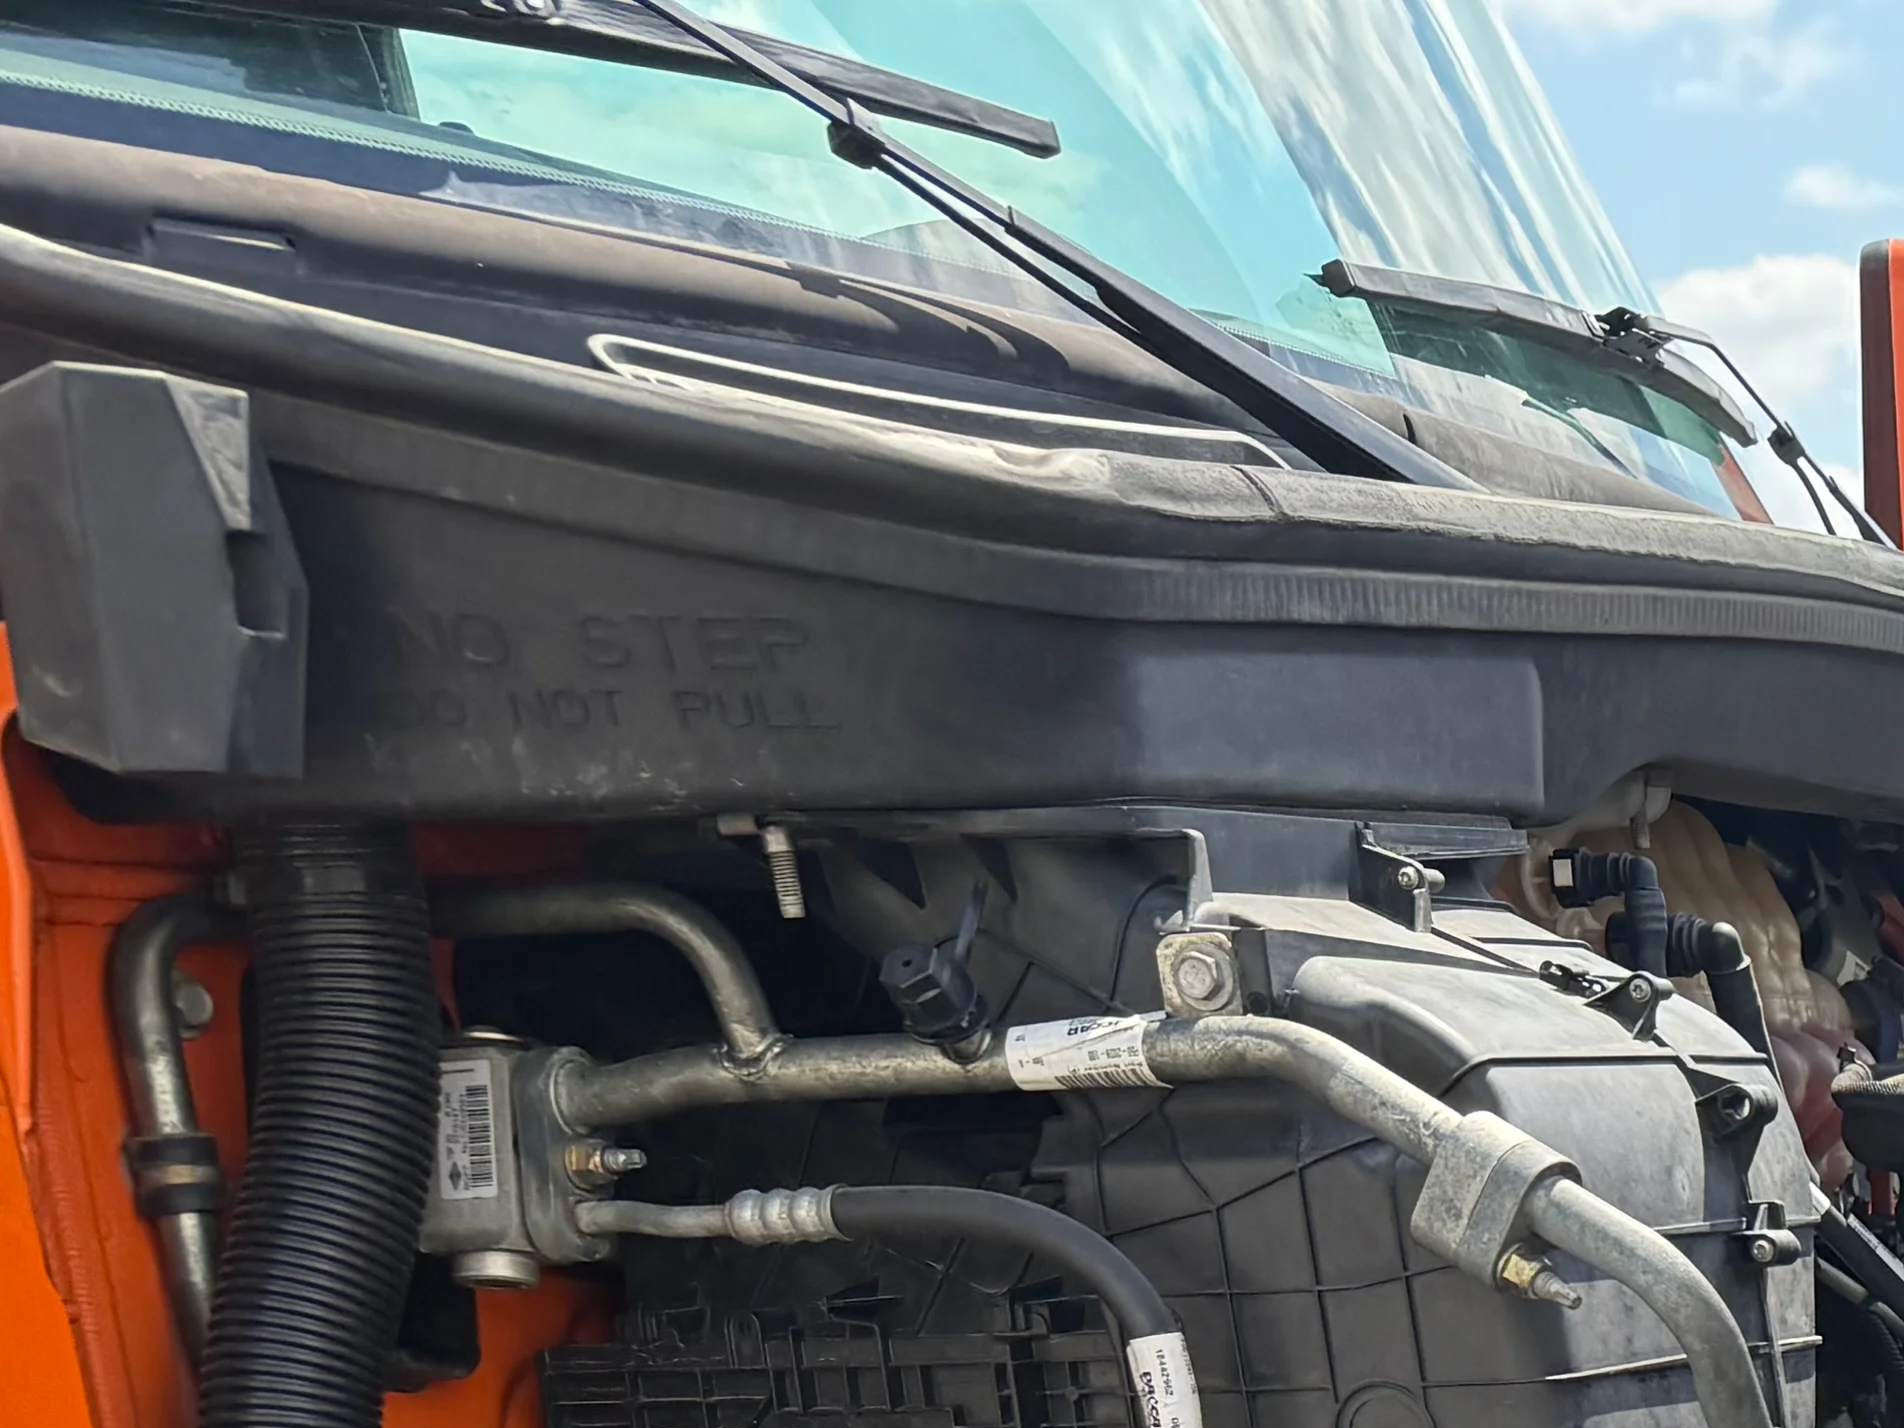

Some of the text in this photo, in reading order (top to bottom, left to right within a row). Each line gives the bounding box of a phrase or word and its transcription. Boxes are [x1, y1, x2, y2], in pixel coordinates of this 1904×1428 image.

[579, 612, 807, 672] STEP
[507, 689, 622, 728] NOT
[672, 689, 840, 730] PULL
